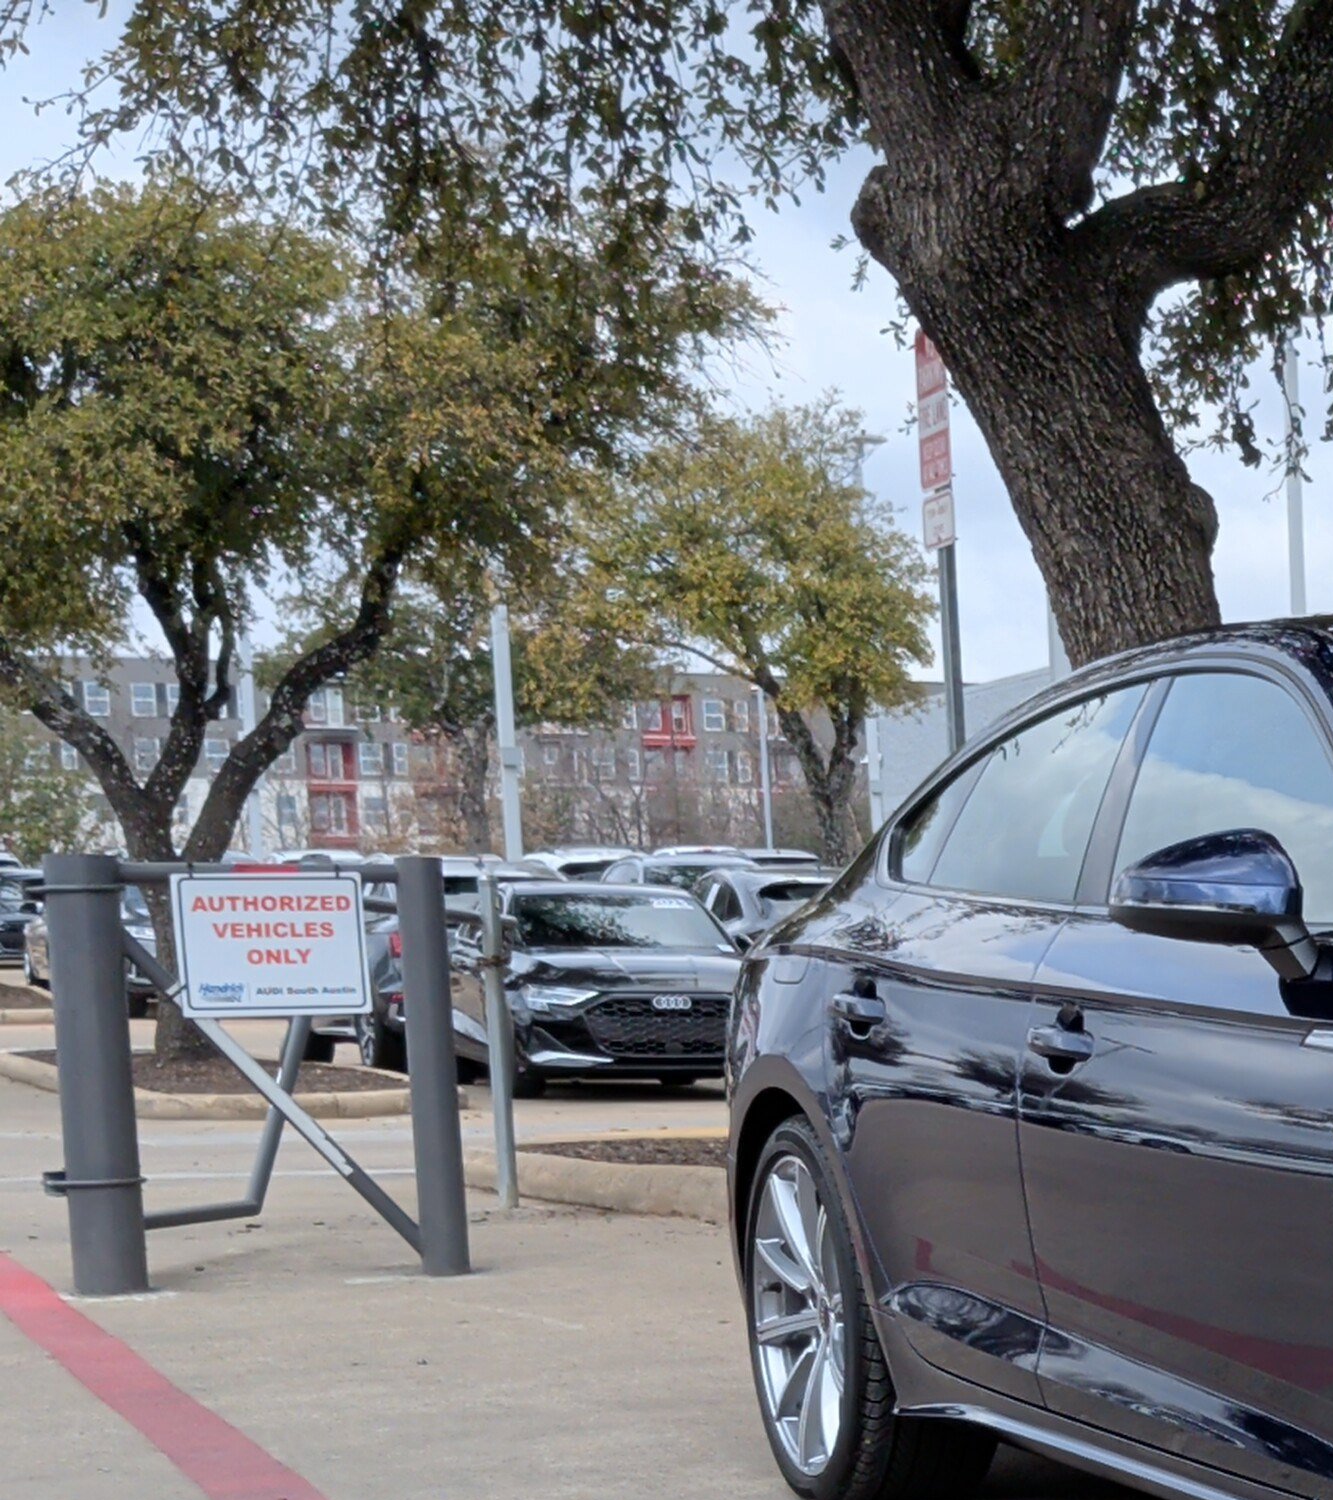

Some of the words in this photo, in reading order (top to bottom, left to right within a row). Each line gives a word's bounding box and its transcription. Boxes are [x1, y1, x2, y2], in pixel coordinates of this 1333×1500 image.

[191, 896, 351, 912] AUTHORIZED
[212, 922, 335, 939] VEHICLES
[246, 948, 312, 965] ONLY
[256, 986, 284, 996] AUDI
[287, 986, 319, 995] South
[321, 985, 357, 995] Austin
